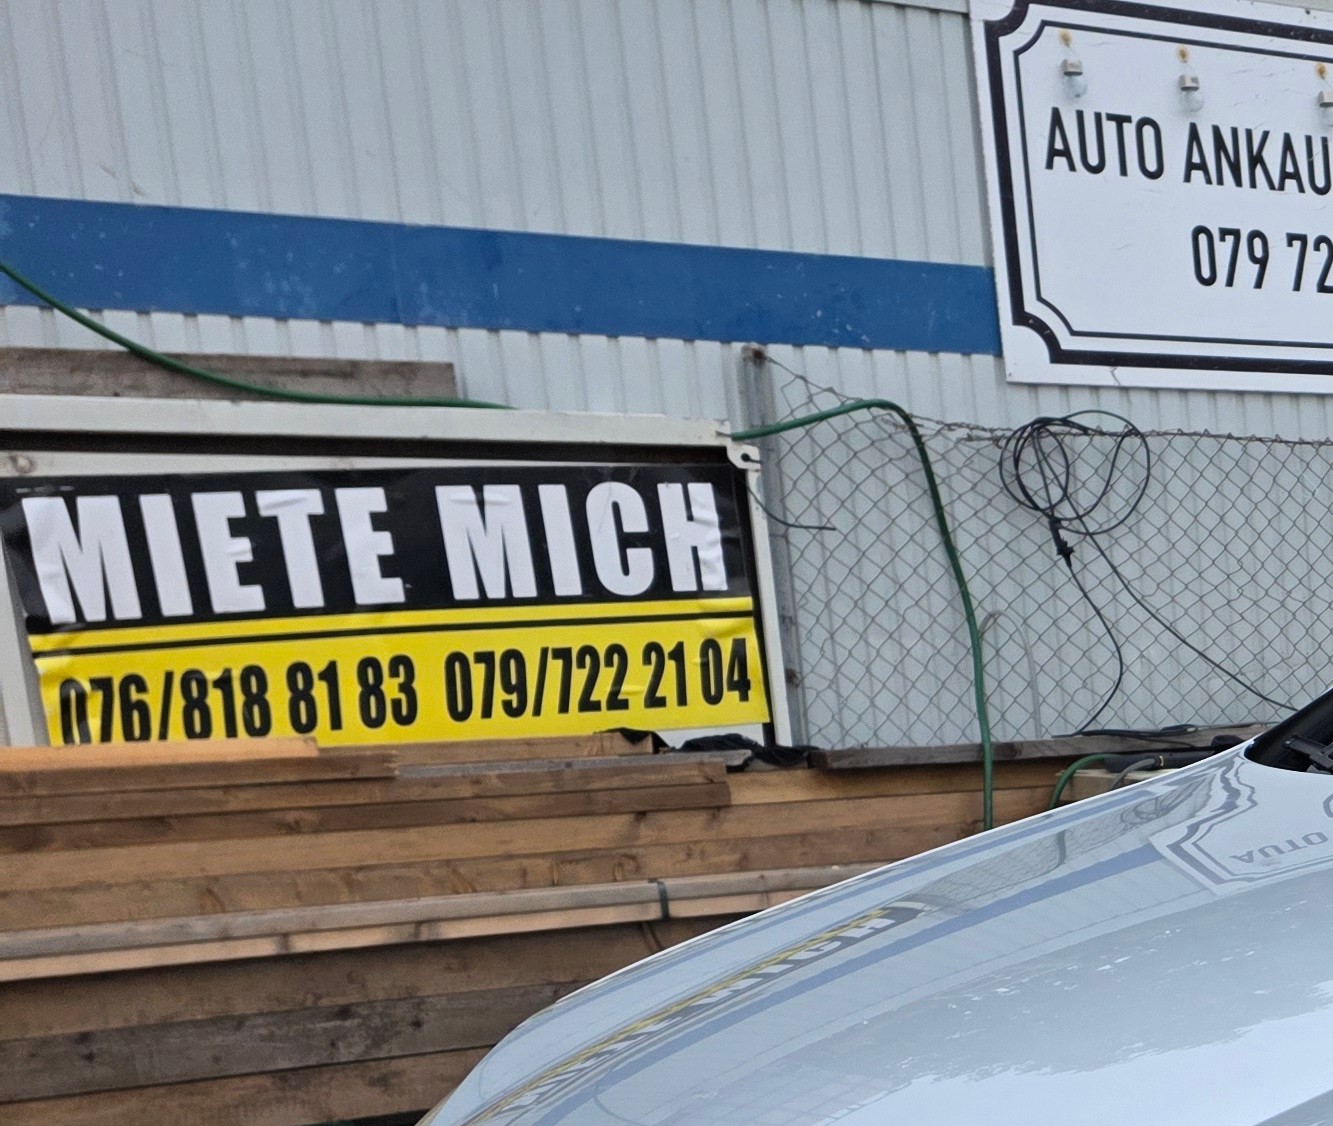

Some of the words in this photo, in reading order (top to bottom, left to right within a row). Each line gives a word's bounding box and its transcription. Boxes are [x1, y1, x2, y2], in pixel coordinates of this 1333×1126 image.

[1045, 106, 1165, 181] AUTO
[1191, 224, 1271, 290] 079
[21, 487, 406, 625] MIETE
[434, 480, 730, 601] MICH
[58, 663, 272, 748] 076/818
[285, 660, 344, 735] 81
[356, 653, 420, 730] 83
[444, 641, 631, 724] 079/722
[642, 639, 688, 711] 21
[699, 635, 753, 704] 04
